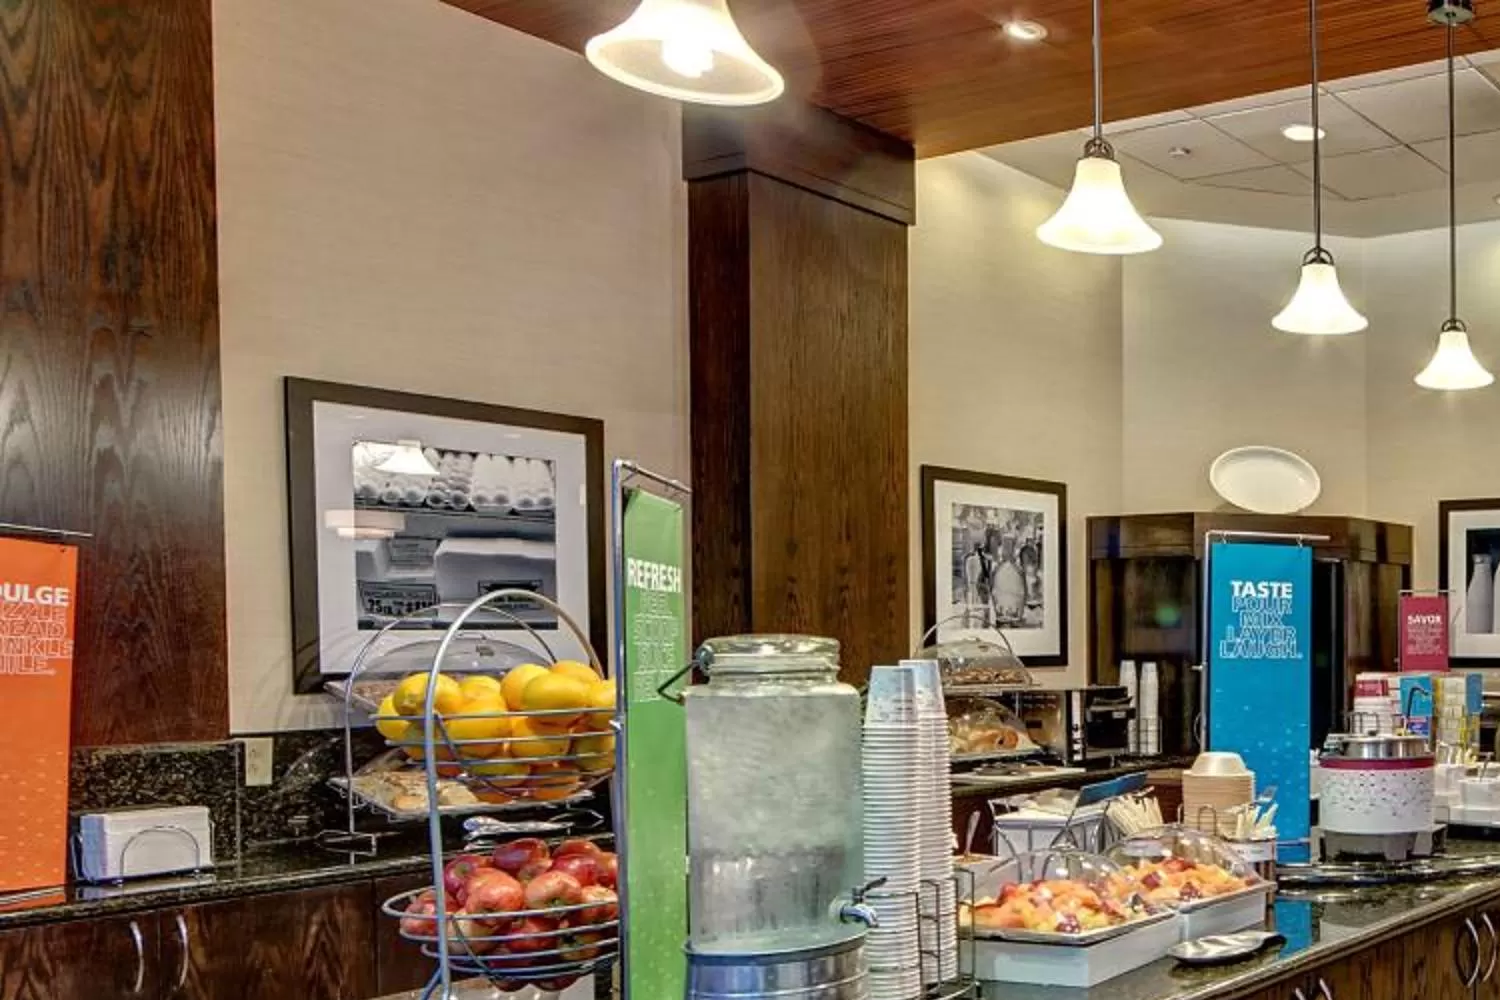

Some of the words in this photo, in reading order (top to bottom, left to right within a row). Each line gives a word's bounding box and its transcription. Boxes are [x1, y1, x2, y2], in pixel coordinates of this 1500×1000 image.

[627, 557, 682, 592] REFRESH
[0, 582, 70, 607] ULGE
[1230, 580, 1293, 599] TASTE
[1231, 596, 1293, 614] POUR
[1240, 610, 1286, 629] MIX
[1407, 615, 1442, 625] SAVOR
[1226, 625, 1297, 645] LAYER
